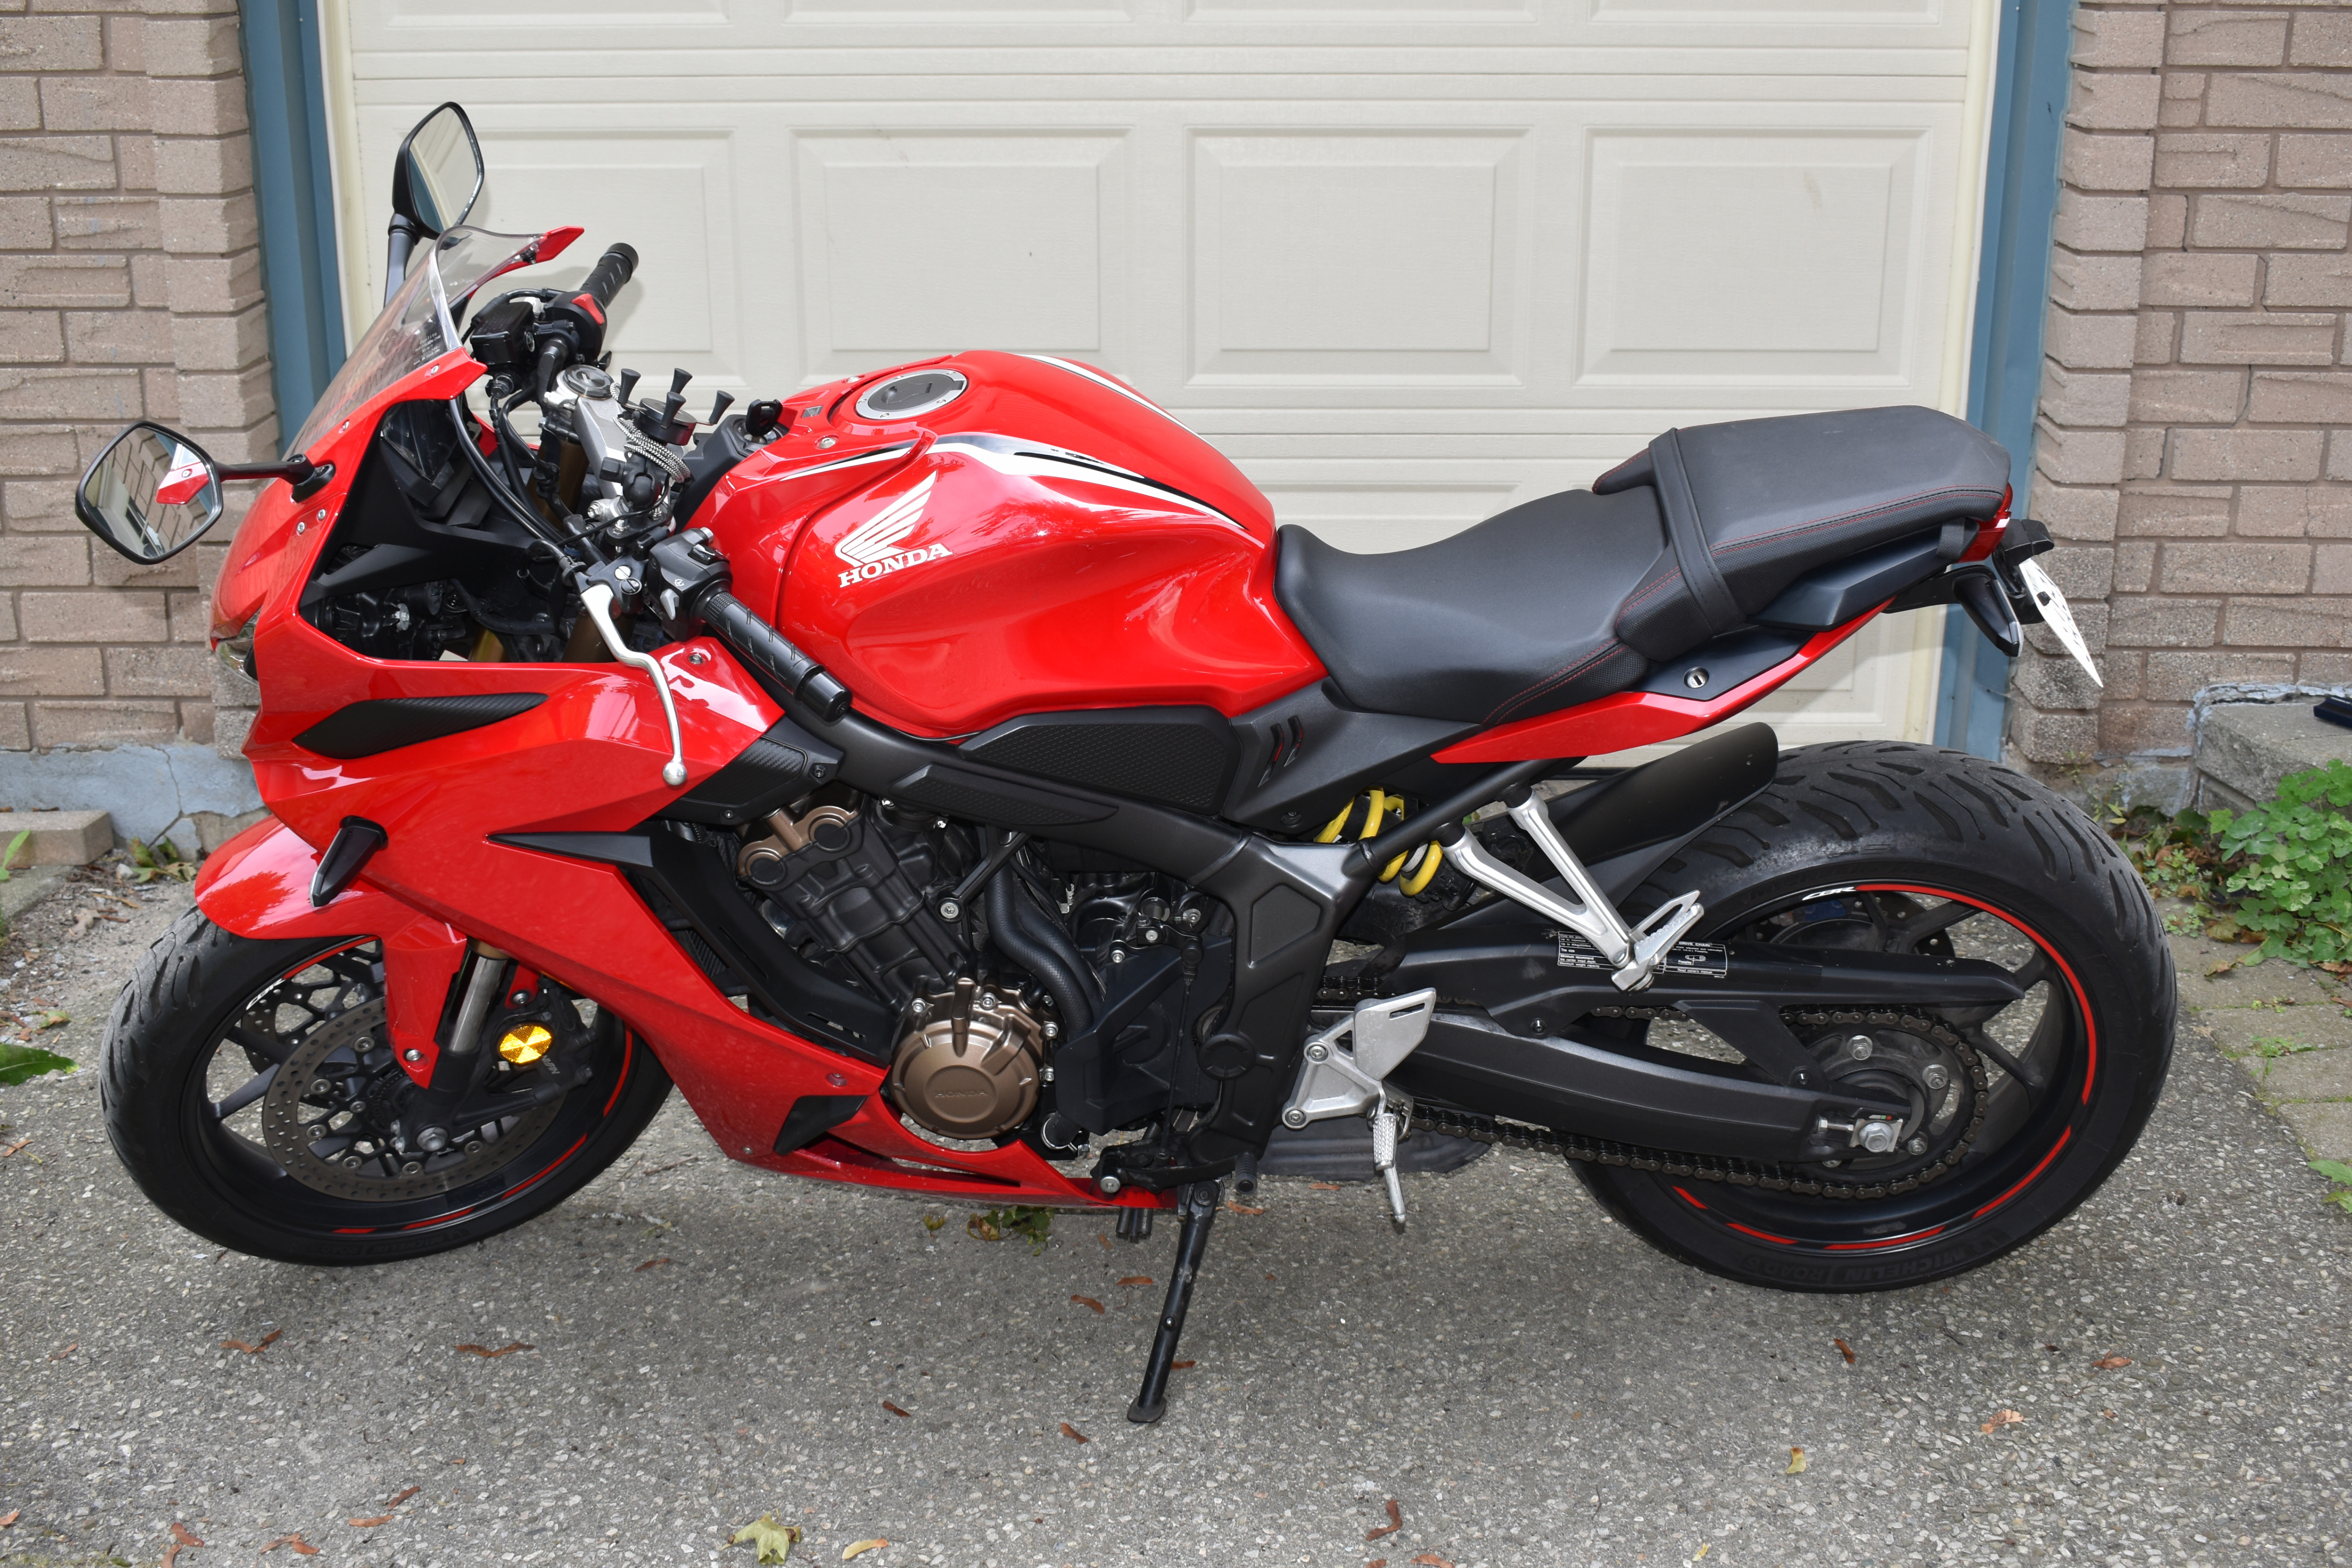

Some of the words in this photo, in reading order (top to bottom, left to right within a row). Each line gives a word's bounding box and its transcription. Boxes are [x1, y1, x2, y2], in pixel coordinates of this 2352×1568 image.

[838, 543, 953, 588] HONDA
[1802, 887, 1857, 901] CBR
[246, 978, 287, 1010] CBR
[935, 1089, 988, 1098] HONDA
[321, 1245, 359, 1255] ROAD
[373, 1234, 443, 1254] MICHELIN
[1764, 1261, 1826, 1282] ROAD
[1843, 1248, 1965, 1283] MICHELIN
